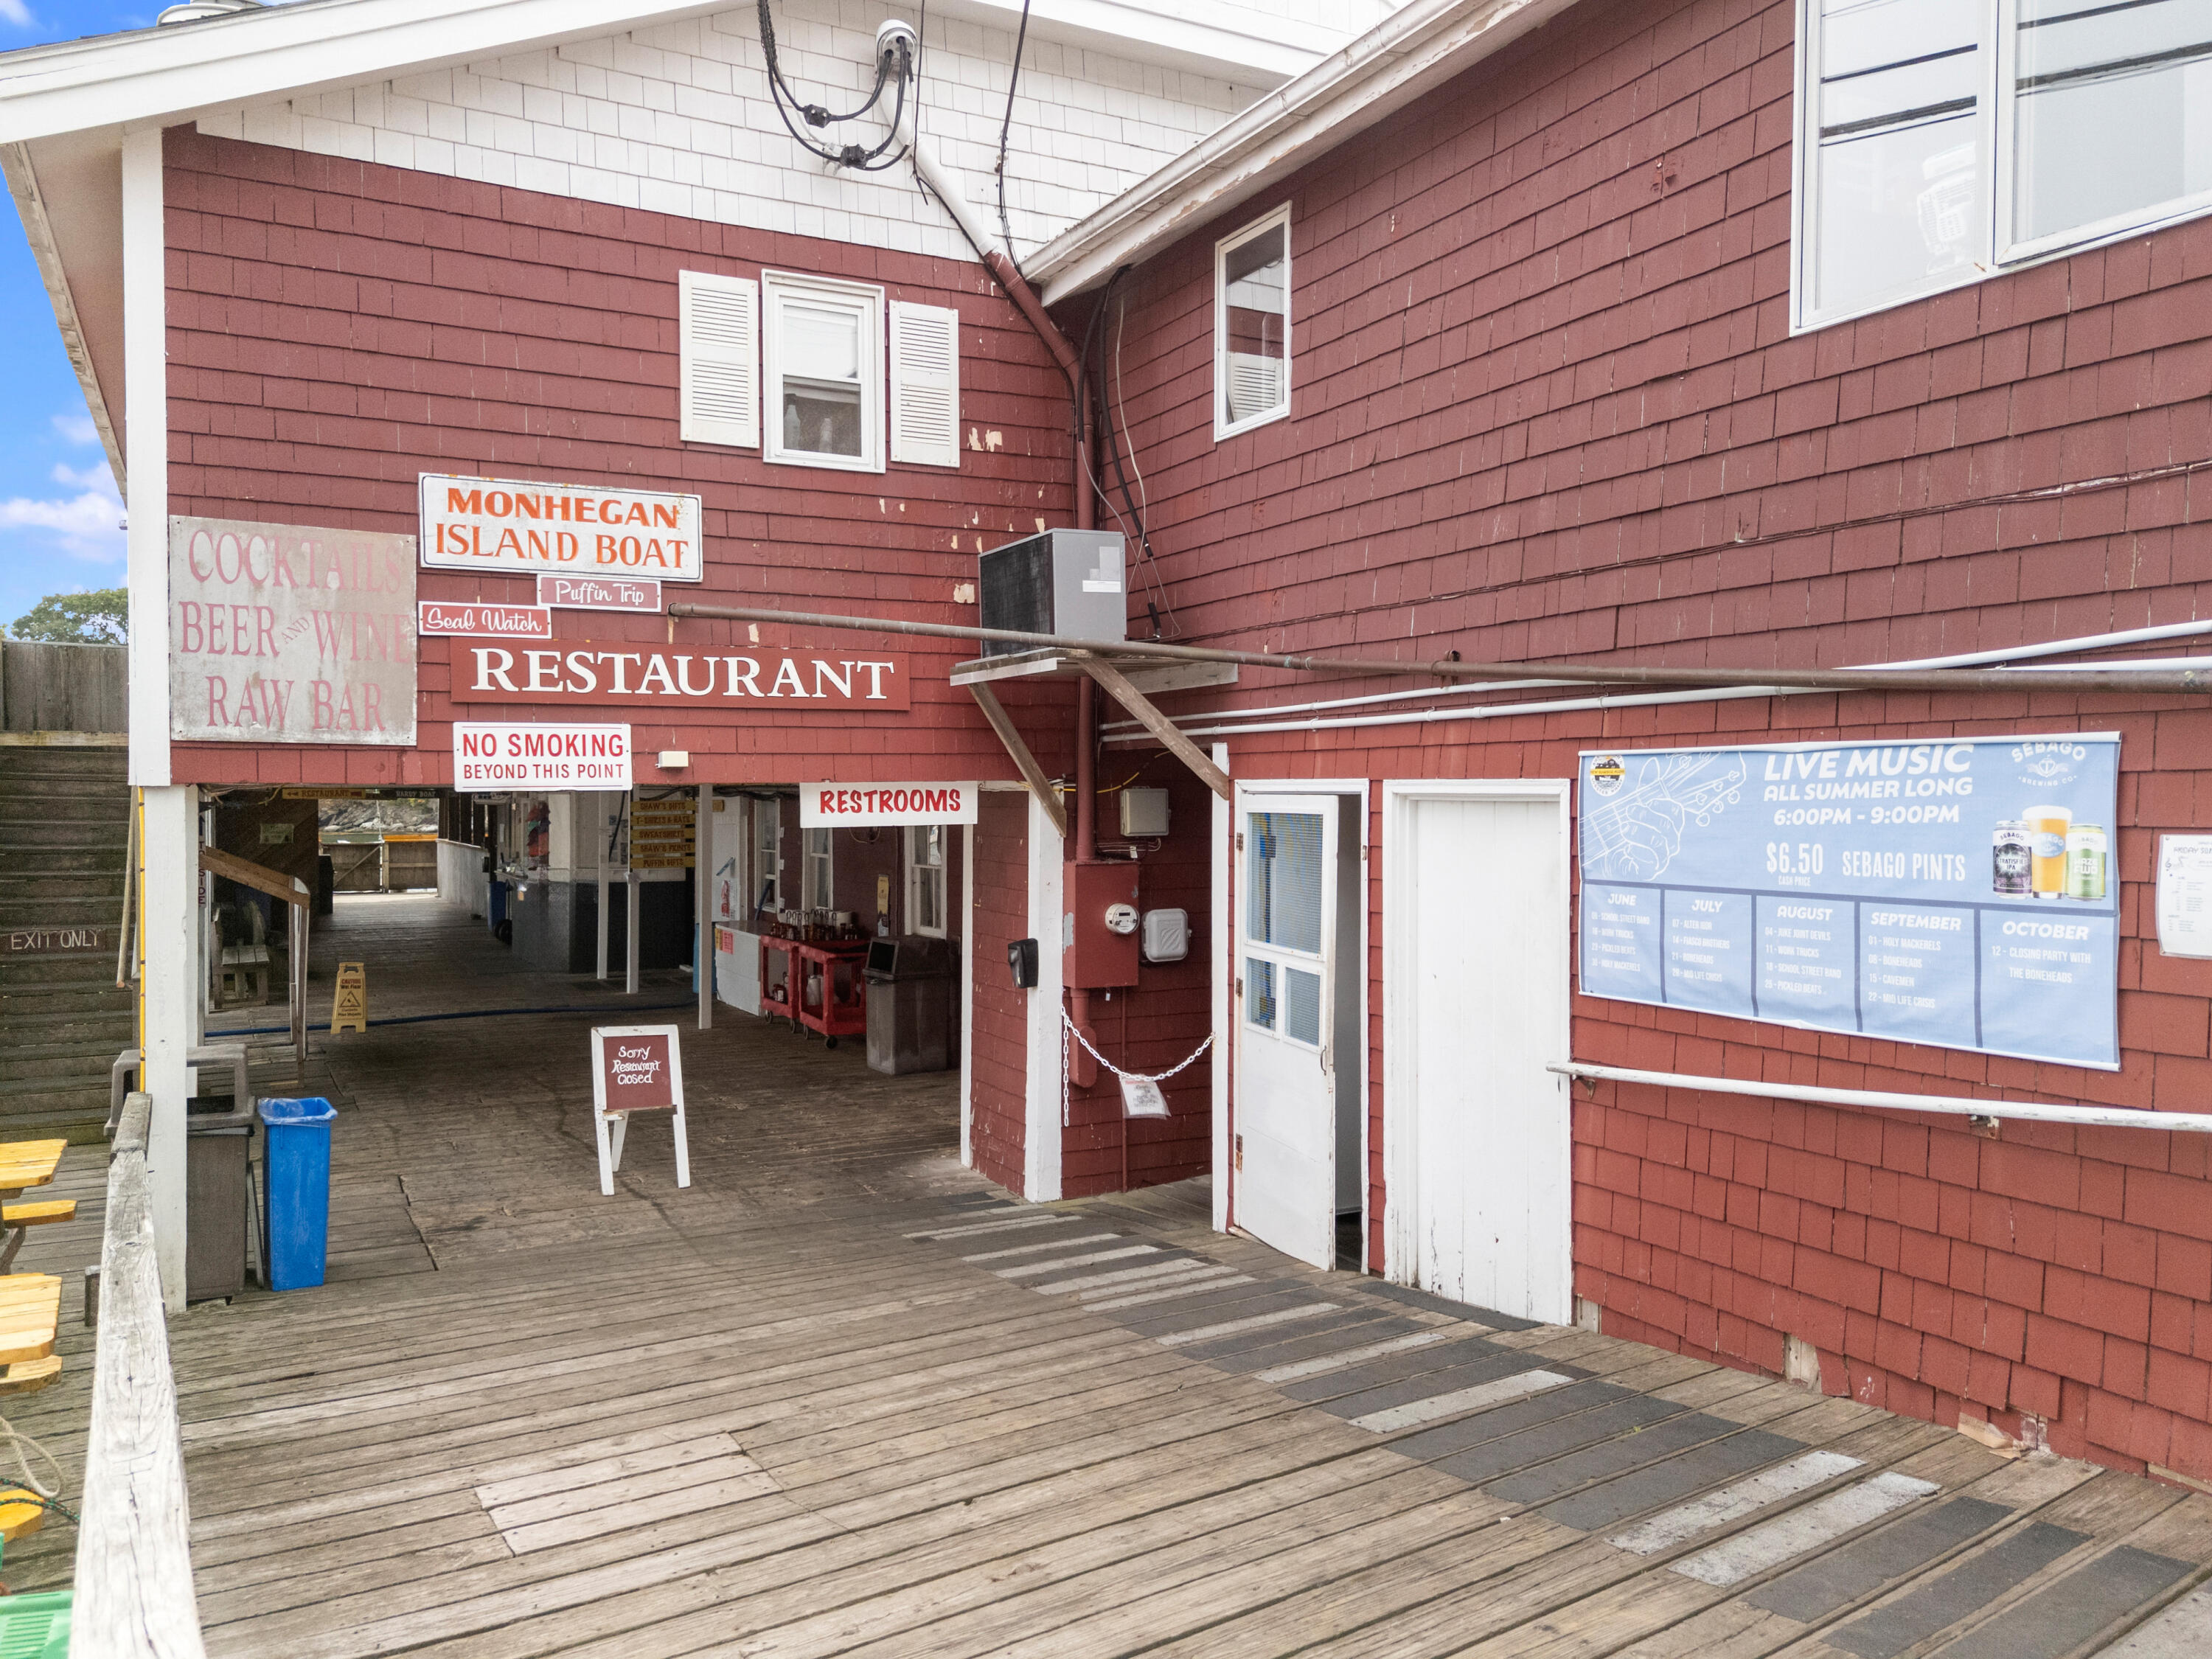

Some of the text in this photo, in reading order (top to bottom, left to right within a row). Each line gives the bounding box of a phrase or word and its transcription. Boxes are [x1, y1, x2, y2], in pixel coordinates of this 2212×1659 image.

[447, 487, 678, 529] MONHEGAN
[436, 523, 689, 569] ISLAND BOAT
[189, 530, 402, 592] COCKTAILS
[555, 580, 645, 606] Puffin Trip
[426, 608, 543, 633] Seal Watch
[180, 602, 414, 663] BEER AND WINE
[470, 647, 894, 700] RESTAURANT
[206, 675, 385, 732] RAW BAR
[462, 734, 624, 759] NO SMOKING
[2011, 742, 2086, 762] SEBAGO
[1764, 744, 1974, 781] LIVE MUSIC
[464, 764, 624, 779] BEYOND THIS POINT
[1764, 777, 1973, 801] ALL SUMMER LONG
[2022, 777, 2058, 787] BREWING
[302, 789, 349, 797] RESTAURANT
[669, 801, 686, 810] GIFTS
[820, 789, 961, 814] RESTROOMS
[1773, 807, 1851, 826] 6:00PM
[1871, 804, 1959, 824] 9:00PM
[639, 830, 685, 838] SWEATSHIRTS
[643, 858, 684, 868] PUFFIN GIFTS
[1766, 841, 1823, 874] $6.50
[1843, 850, 1966, 881] SEBAGO PINTS
[1778, 875, 1811, 886] CASH PRICE
[1607, 893, 1638, 905] JUNE
[1691, 899, 1723, 913] JULY
[1620, 914, 1636, 923] STREET
[1777, 905, 1833, 921] AUGUST
[1870, 911, 1962, 931] SEPTEMBER
[1810, 930, 1831, 941] DEVILS
[2002, 920, 2089, 941] OCTOBER
[11, 929, 101, 950] EXIT ONLY
[1672, 935, 1680, 944] 14
[1868, 935, 1877, 945] 01
[1882, 936, 1899, 947] HOLY
[1901, 938, 1941, 951] MACKERELS
[1672, 951, 1679, 961] 21
[1766, 944, 1773, 953] 11
[1796, 947, 1820, 958] TRUCKS
[1992, 945, 2001, 956] 12
[2009, 947, 2042, 960] CLOSING
[2042, 949, 2067, 962] PARTY
[2070, 951, 2091, 964] WITH
[1882, 956, 1922, 968] BONEHEADS
[1694, 970, 1705, 980] LIFE
[1778, 963, 1800, 974] SCHOOL
[1801, 965, 1823, 976] STREET
[1824, 967, 1841, 978] BAND
[2009, 967, 2073, 984] THE BONEHEADS
[1778, 980, 1802, 992] PICKLED
[1869, 973, 1877, 983] 15
[1882, 975, 1915, 987] CAVEMEN
[1868, 991, 1877, 1001] 22
[1897, 995, 1912, 1006] LIFE
[1913, 997, 1935, 1009] CRISIS
[618, 1046, 651, 1060] Sorry
[617, 1070, 653, 1085] Closed
